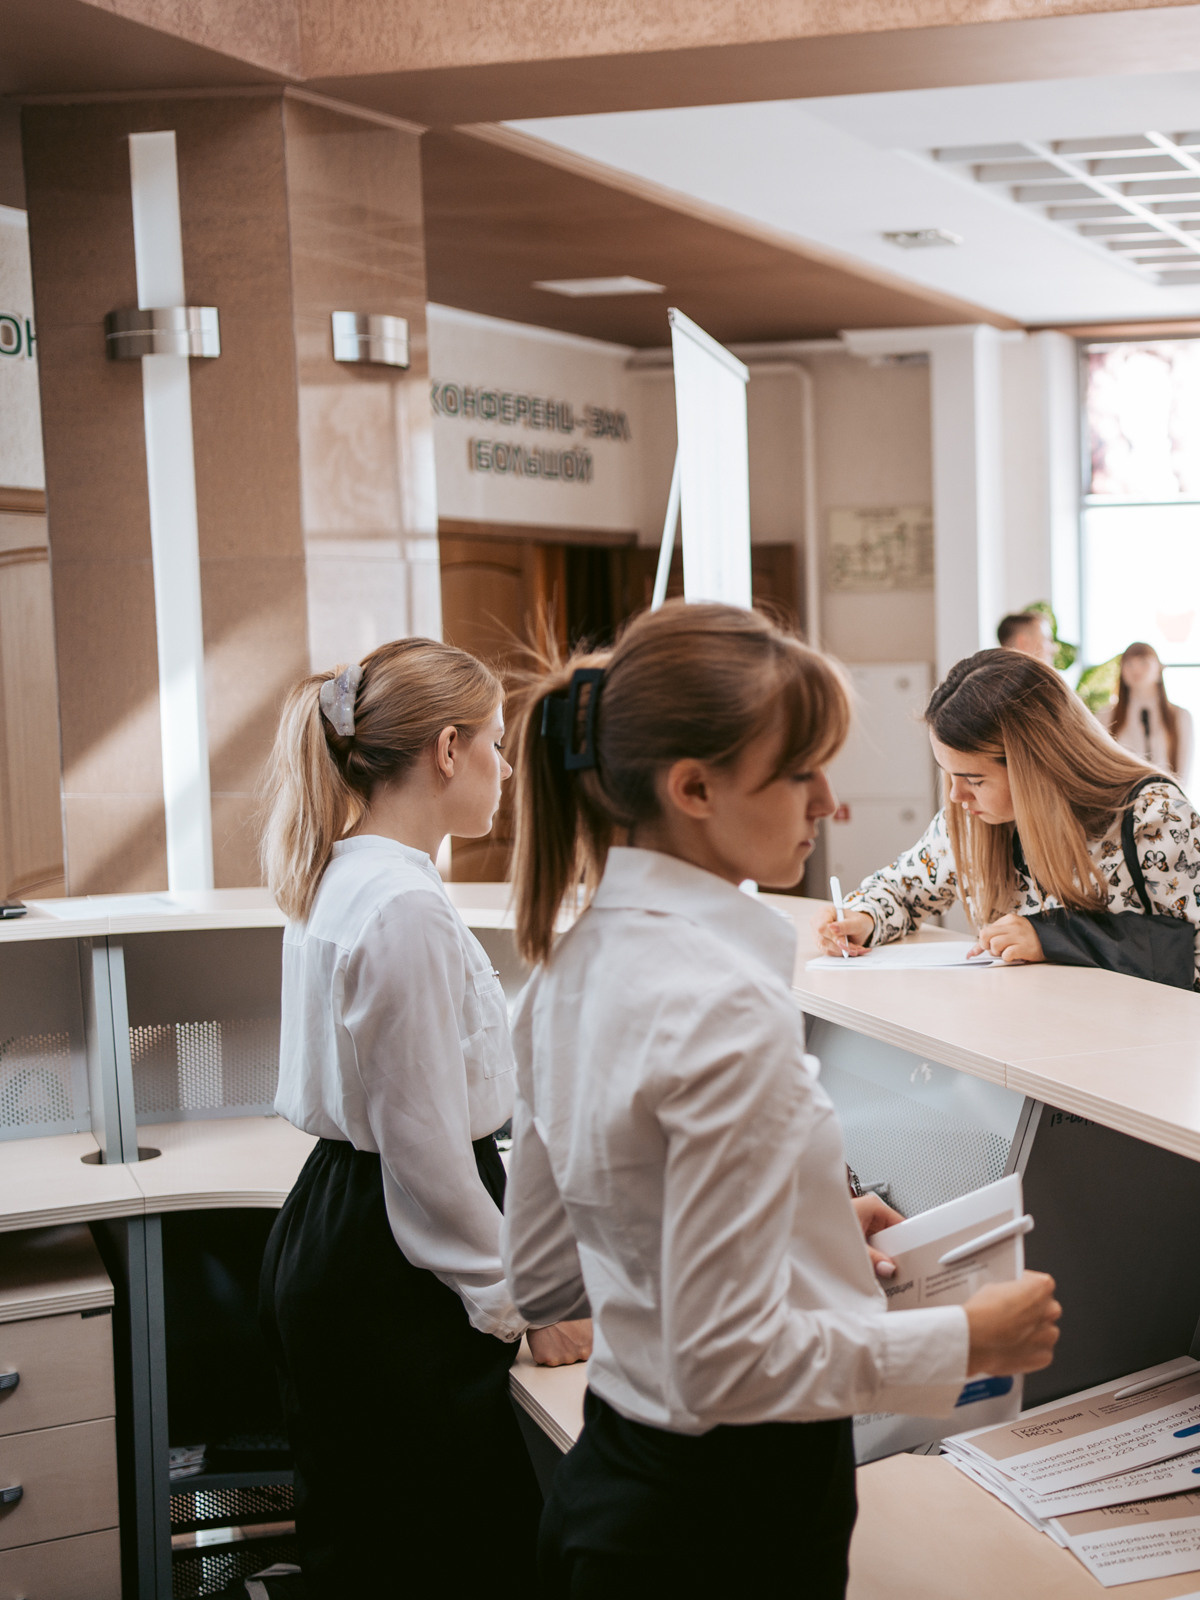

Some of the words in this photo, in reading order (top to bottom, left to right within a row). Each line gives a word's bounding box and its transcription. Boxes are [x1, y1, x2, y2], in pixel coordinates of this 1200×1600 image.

[1020, 1412, 1083, 1434] Корпорация
[1025, 1428, 1054, 1438] МСП
[1011, 1447, 1084, 1471] Расширение
[1086, 1431, 1131, 1450] доступа
[1133, 1410, 1189, 1434] субъектов
[1029, 1460, 1095, 1481] заказчиков
[1097, 1453, 1111, 1463] по
[1111, 1438, 1157, 1457] 223-ФЗ
[1031, 1448, 1105, 1474] самозанятых
[1108, 1430, 1156, 1450] граждан
[1125, 1472, 1173, 1487] 223-ФЗ
[1082, 1532, 1166, 1552] Расширение
[1101, 1538, 1187, 1557] самозанятых
[1096, 1551, 1173, 1569] заказчиков
[1175, 1545, 1191, 1554] по
